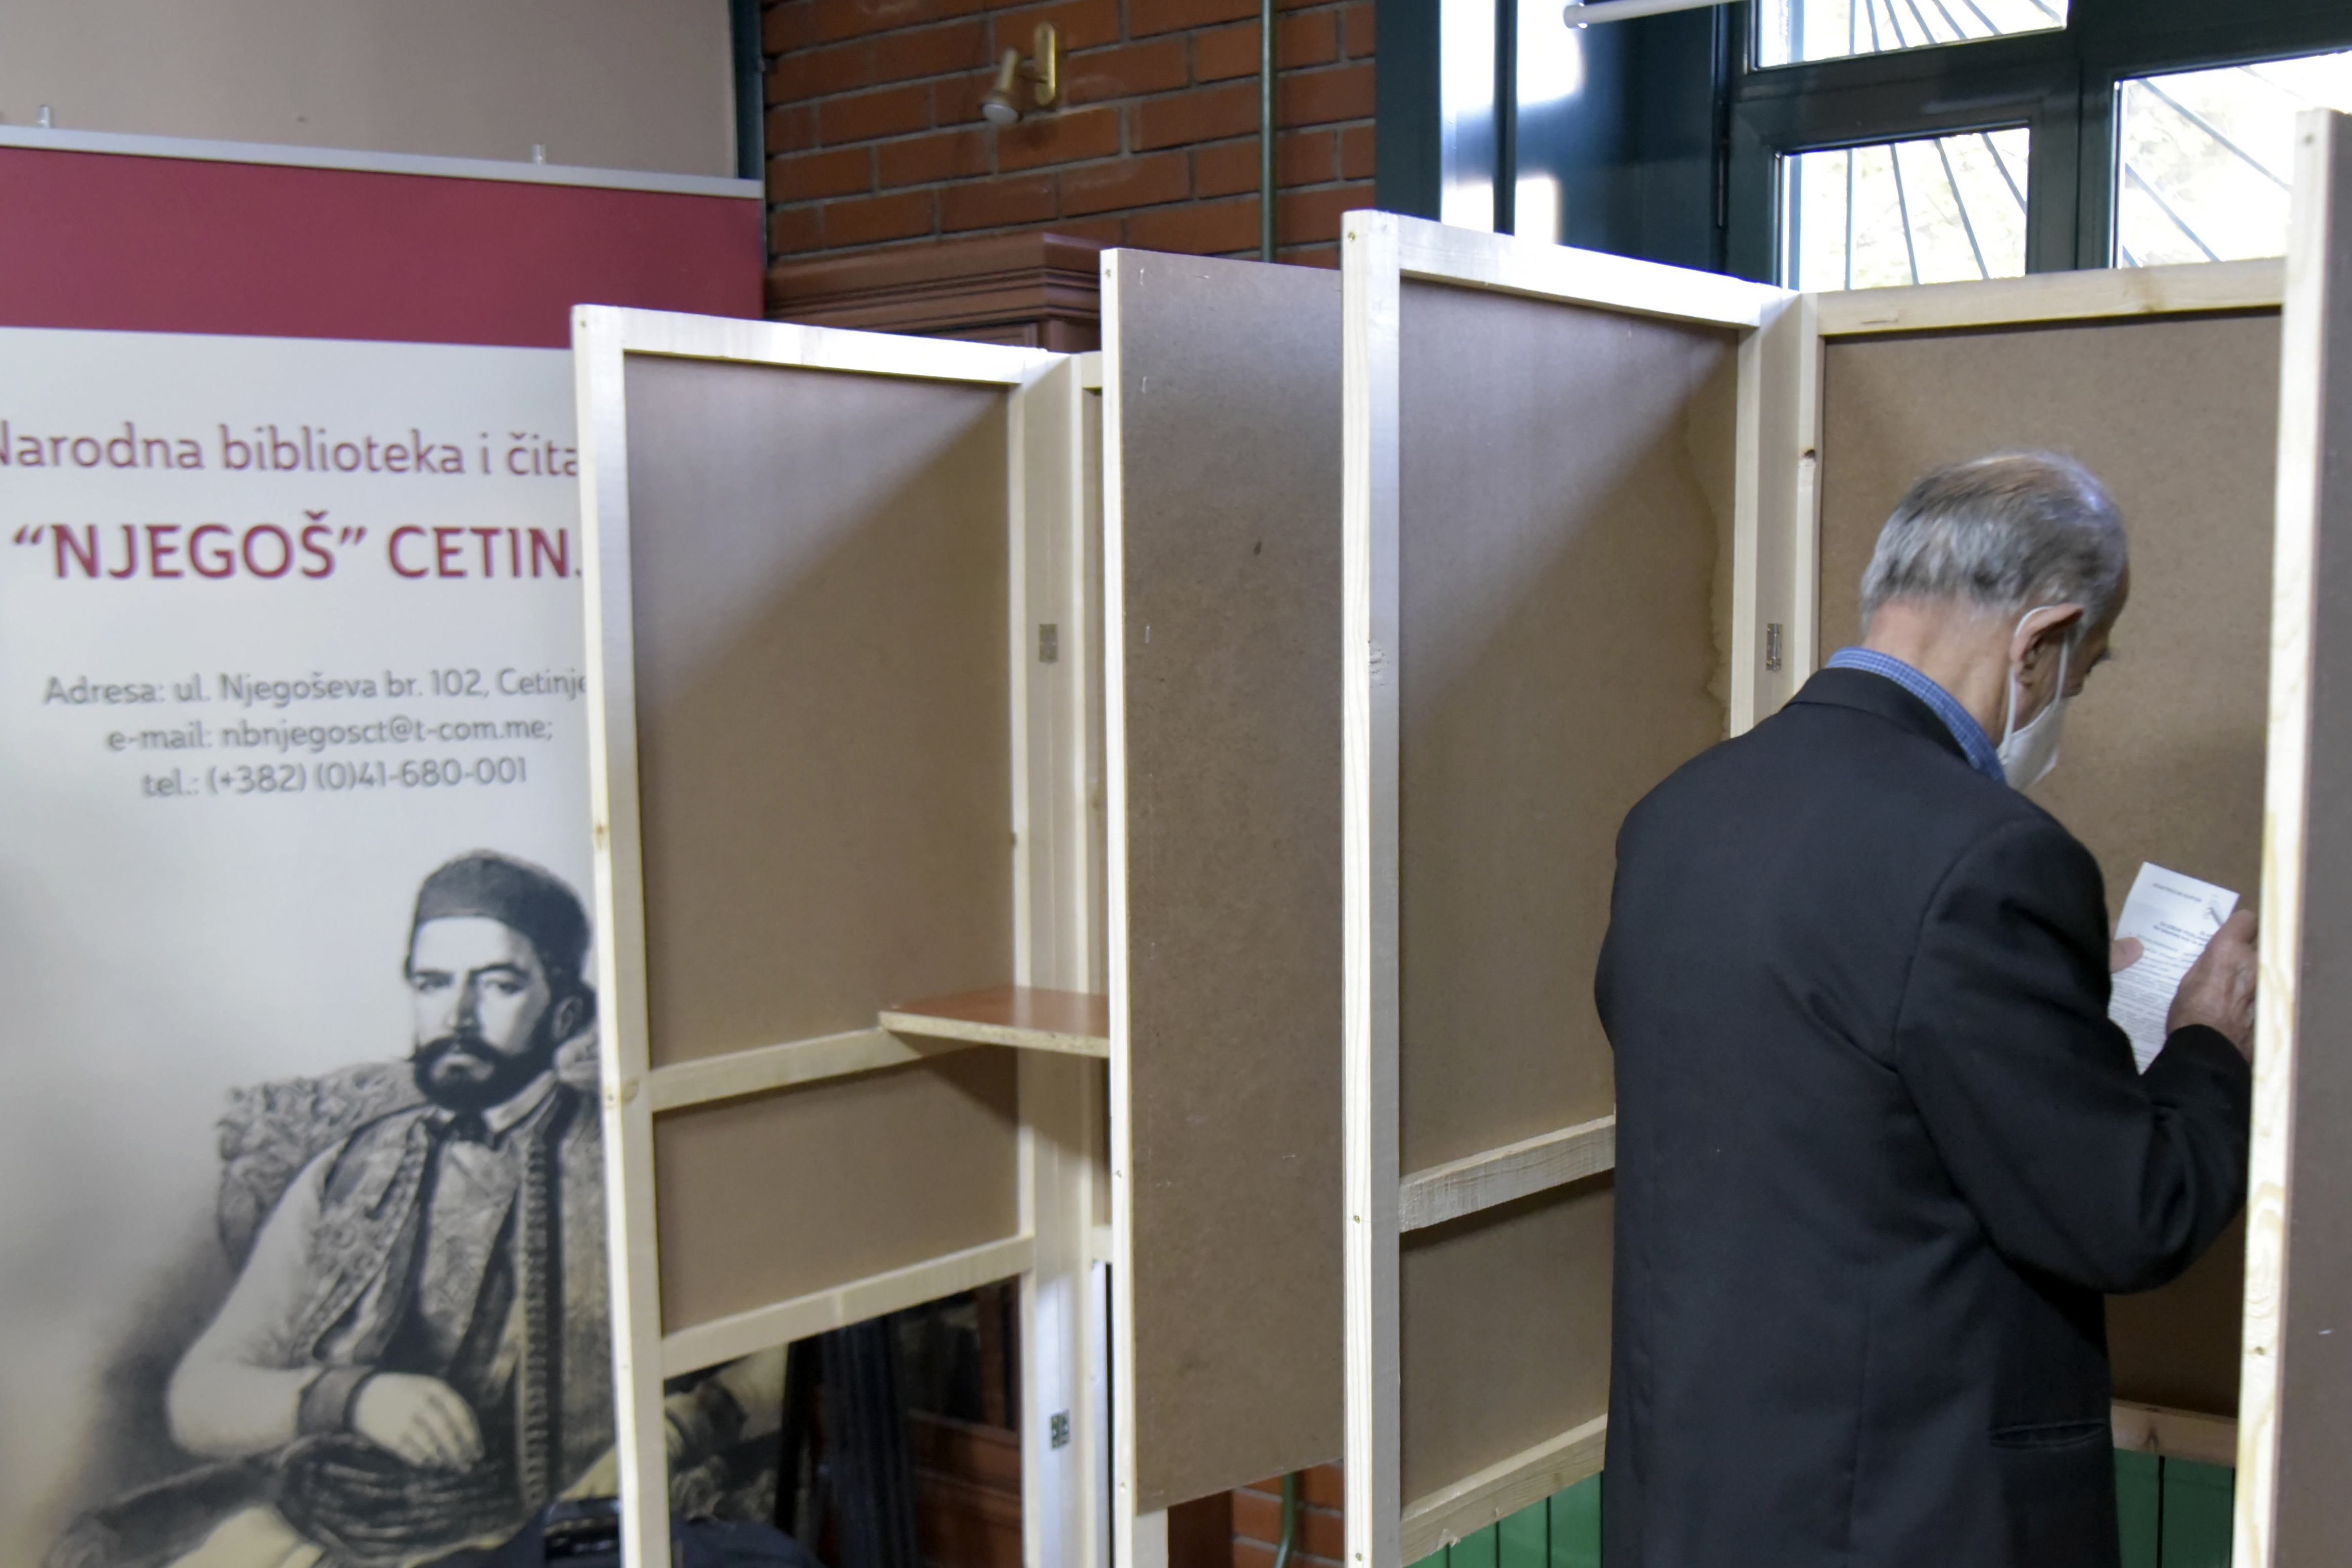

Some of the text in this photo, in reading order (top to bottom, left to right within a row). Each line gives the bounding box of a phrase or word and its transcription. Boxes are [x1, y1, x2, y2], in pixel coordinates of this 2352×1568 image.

[0, 419, 205, 470] arodna
[217, 423, 466, 475] biblioteka
[480, 432, 492, 475] i
[386, 524, 581, 580] CETIN
[43, 675, 165, 705] Adresa:
[174, 673, 210, 703] ul.
[219, 671, 377, 708] Njegoševa
[385, 670, 423, 698] br.
[431, 668, 489, 698] 102,
[106, 713, 553, 753] e-mail: nbnjegosct@t-com.me;
[142, 757, 526, 797] tel.: (+382) (0)41-680-001
